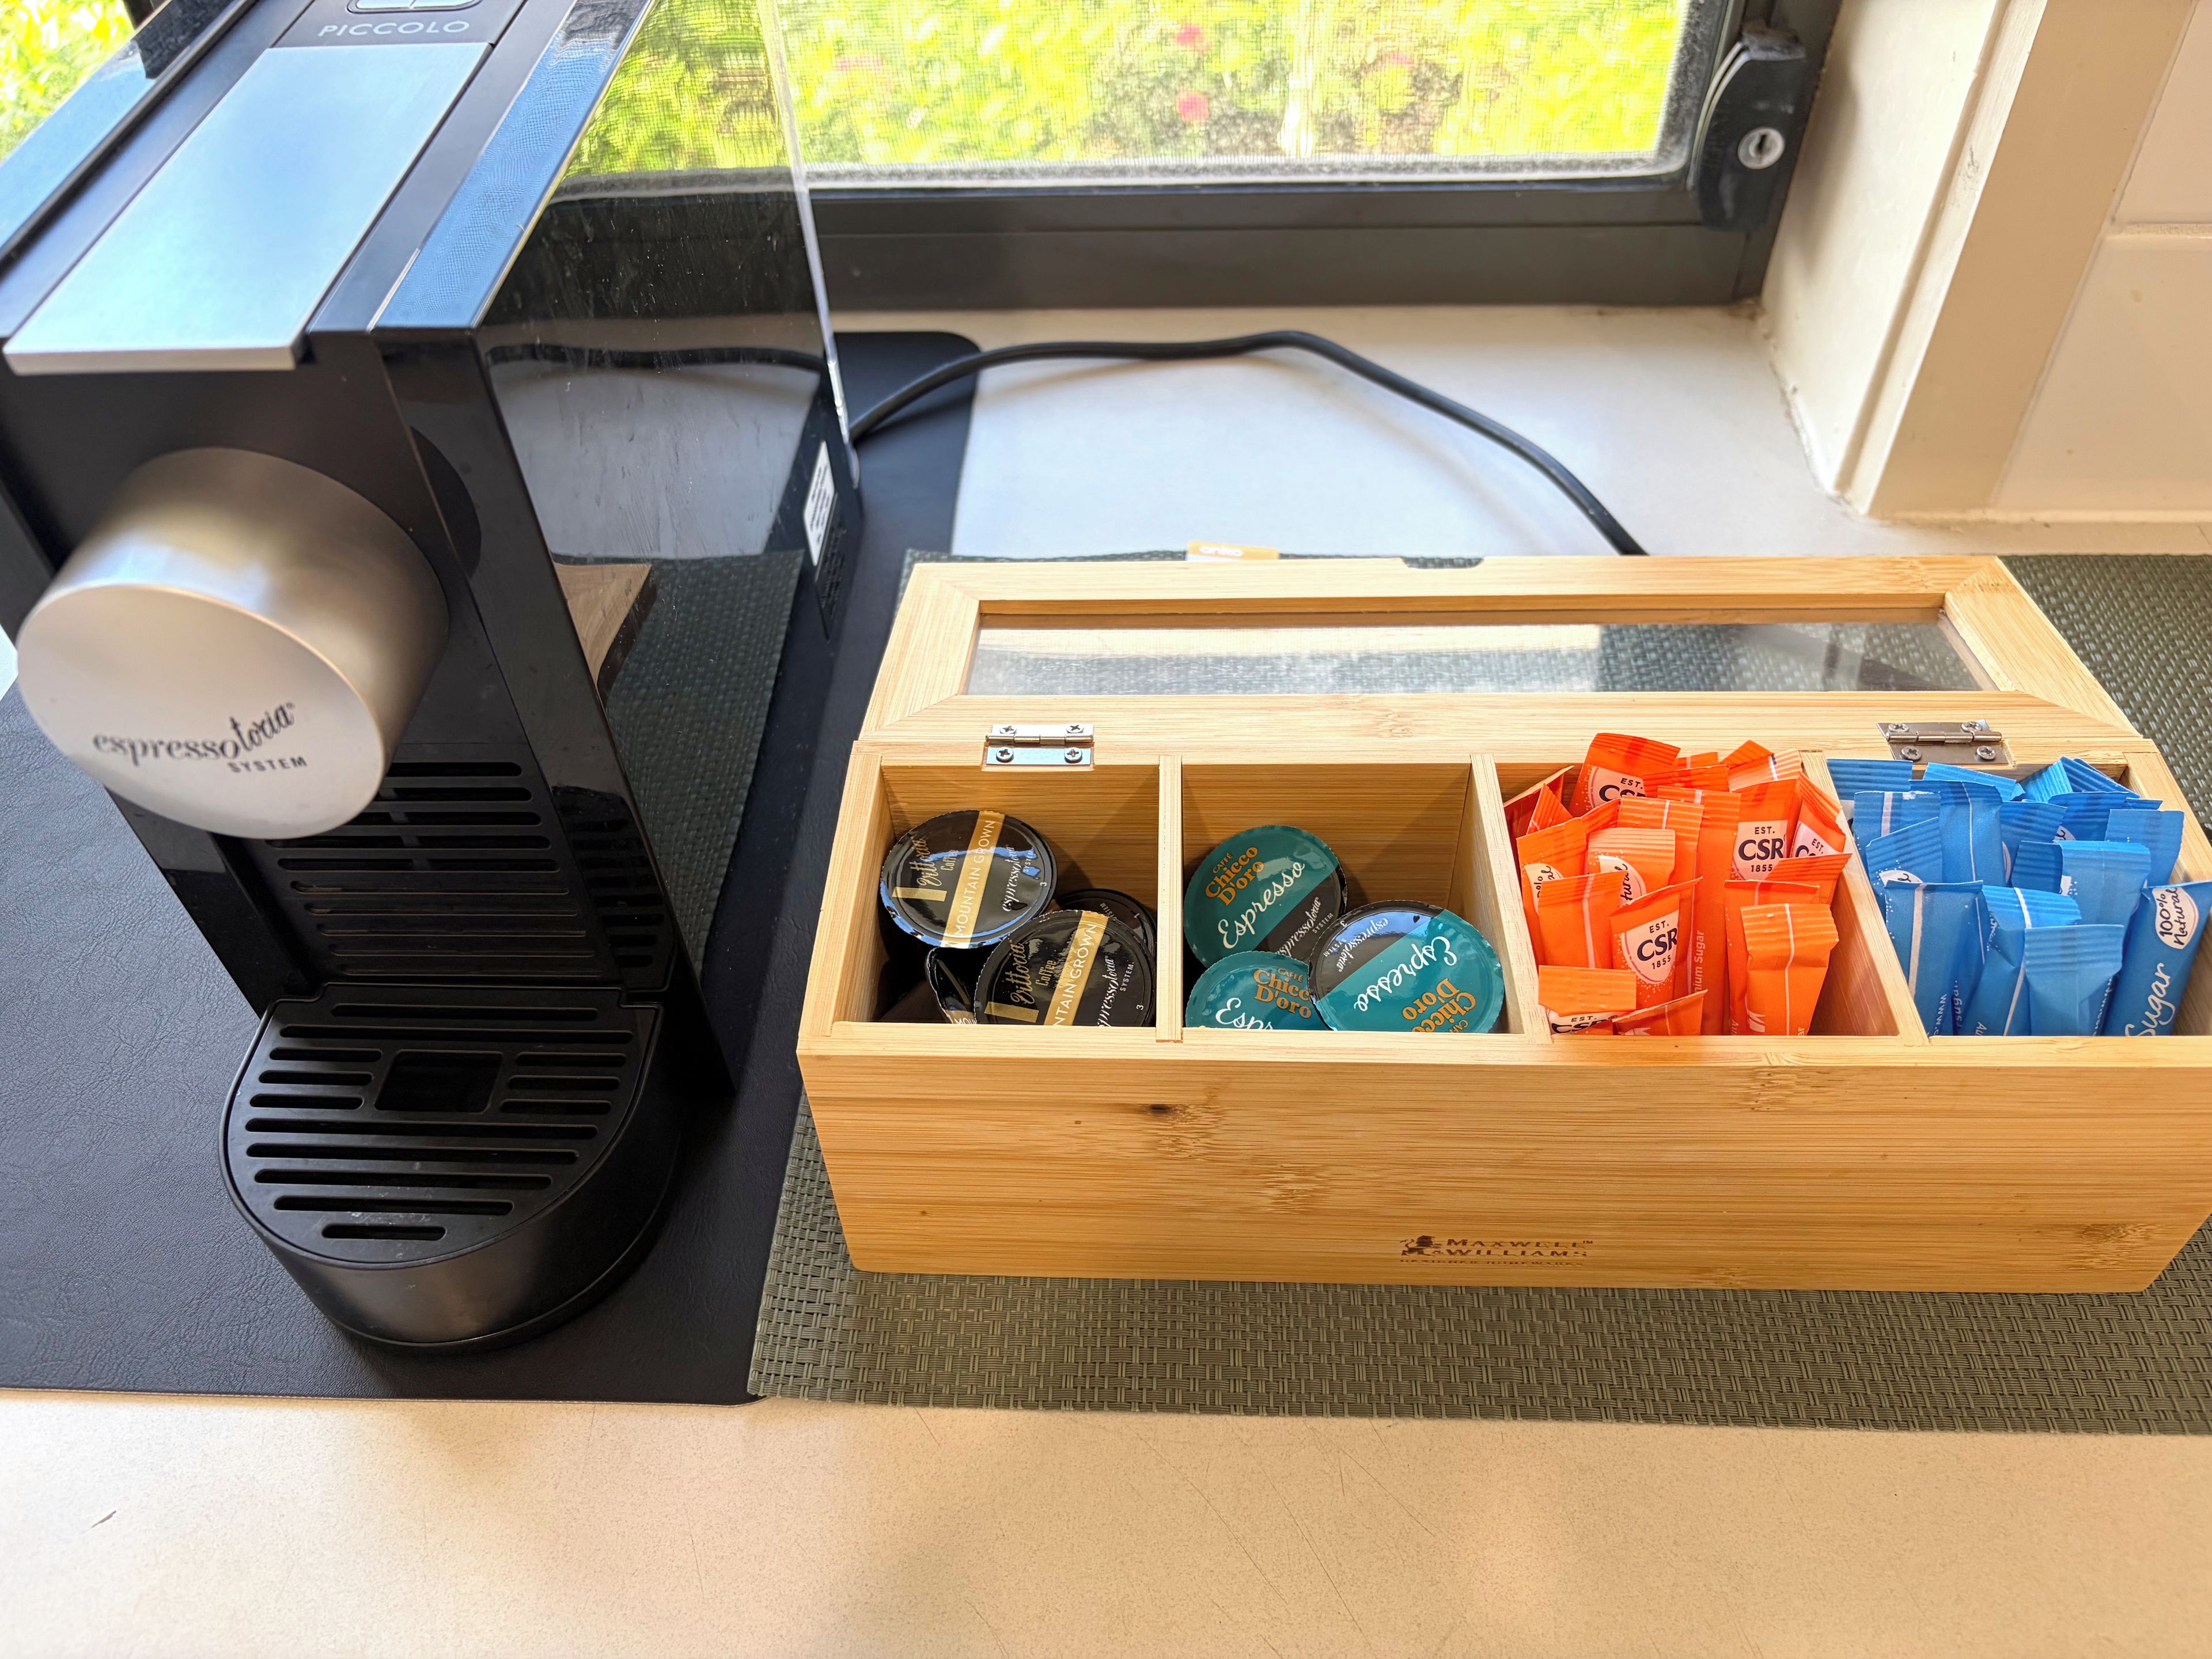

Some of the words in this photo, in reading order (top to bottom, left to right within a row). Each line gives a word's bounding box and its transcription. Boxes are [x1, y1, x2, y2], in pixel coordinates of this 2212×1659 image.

[318, 21, 469, 36] PICCOLO
[227, 756, 308, 773] SYSTEM
[1620, 778, 1643, 790] EST.
[1755, 827, 1775, 835] EST.
[1205, 847, 1259, 898] Chicco
[1212, 853, 1233, 873] CAFFÉ
[1751, 864, 1773, 872] 1855
[953, 867, 982, 936] MOUNTAIN
[972, 820, 996, 864] GROWN
[1217, 861, 1265, 906] D'oro
[1218, 862, 1305, 949] Espresso
[2157, 893, 2173, 937] 100%
[1312, 912, 1334, 934] SYSTEM
[1649, 921, 1669, 934] EST.
[1323, 938, 1347, 957] SYSTEM
[1637, 927, 1677, 961] CSR
[1035, 960, 1056, 986] Coffee
[1052, 982, 1078, 1026] NTAIN
[1070, 922, 1098, 979] GROWN
[1354, 936, 1457, 1012] Espresso
[1652, 955, 1671, 969] 1855
[1253, 969, 1309, 1001] Chicc
[1254, 984, 1312, 1019] D'oro
[1402, 978, 1460, 1021] D'oro
[1446, 1249, 1588, 1257] WILLIAMS
